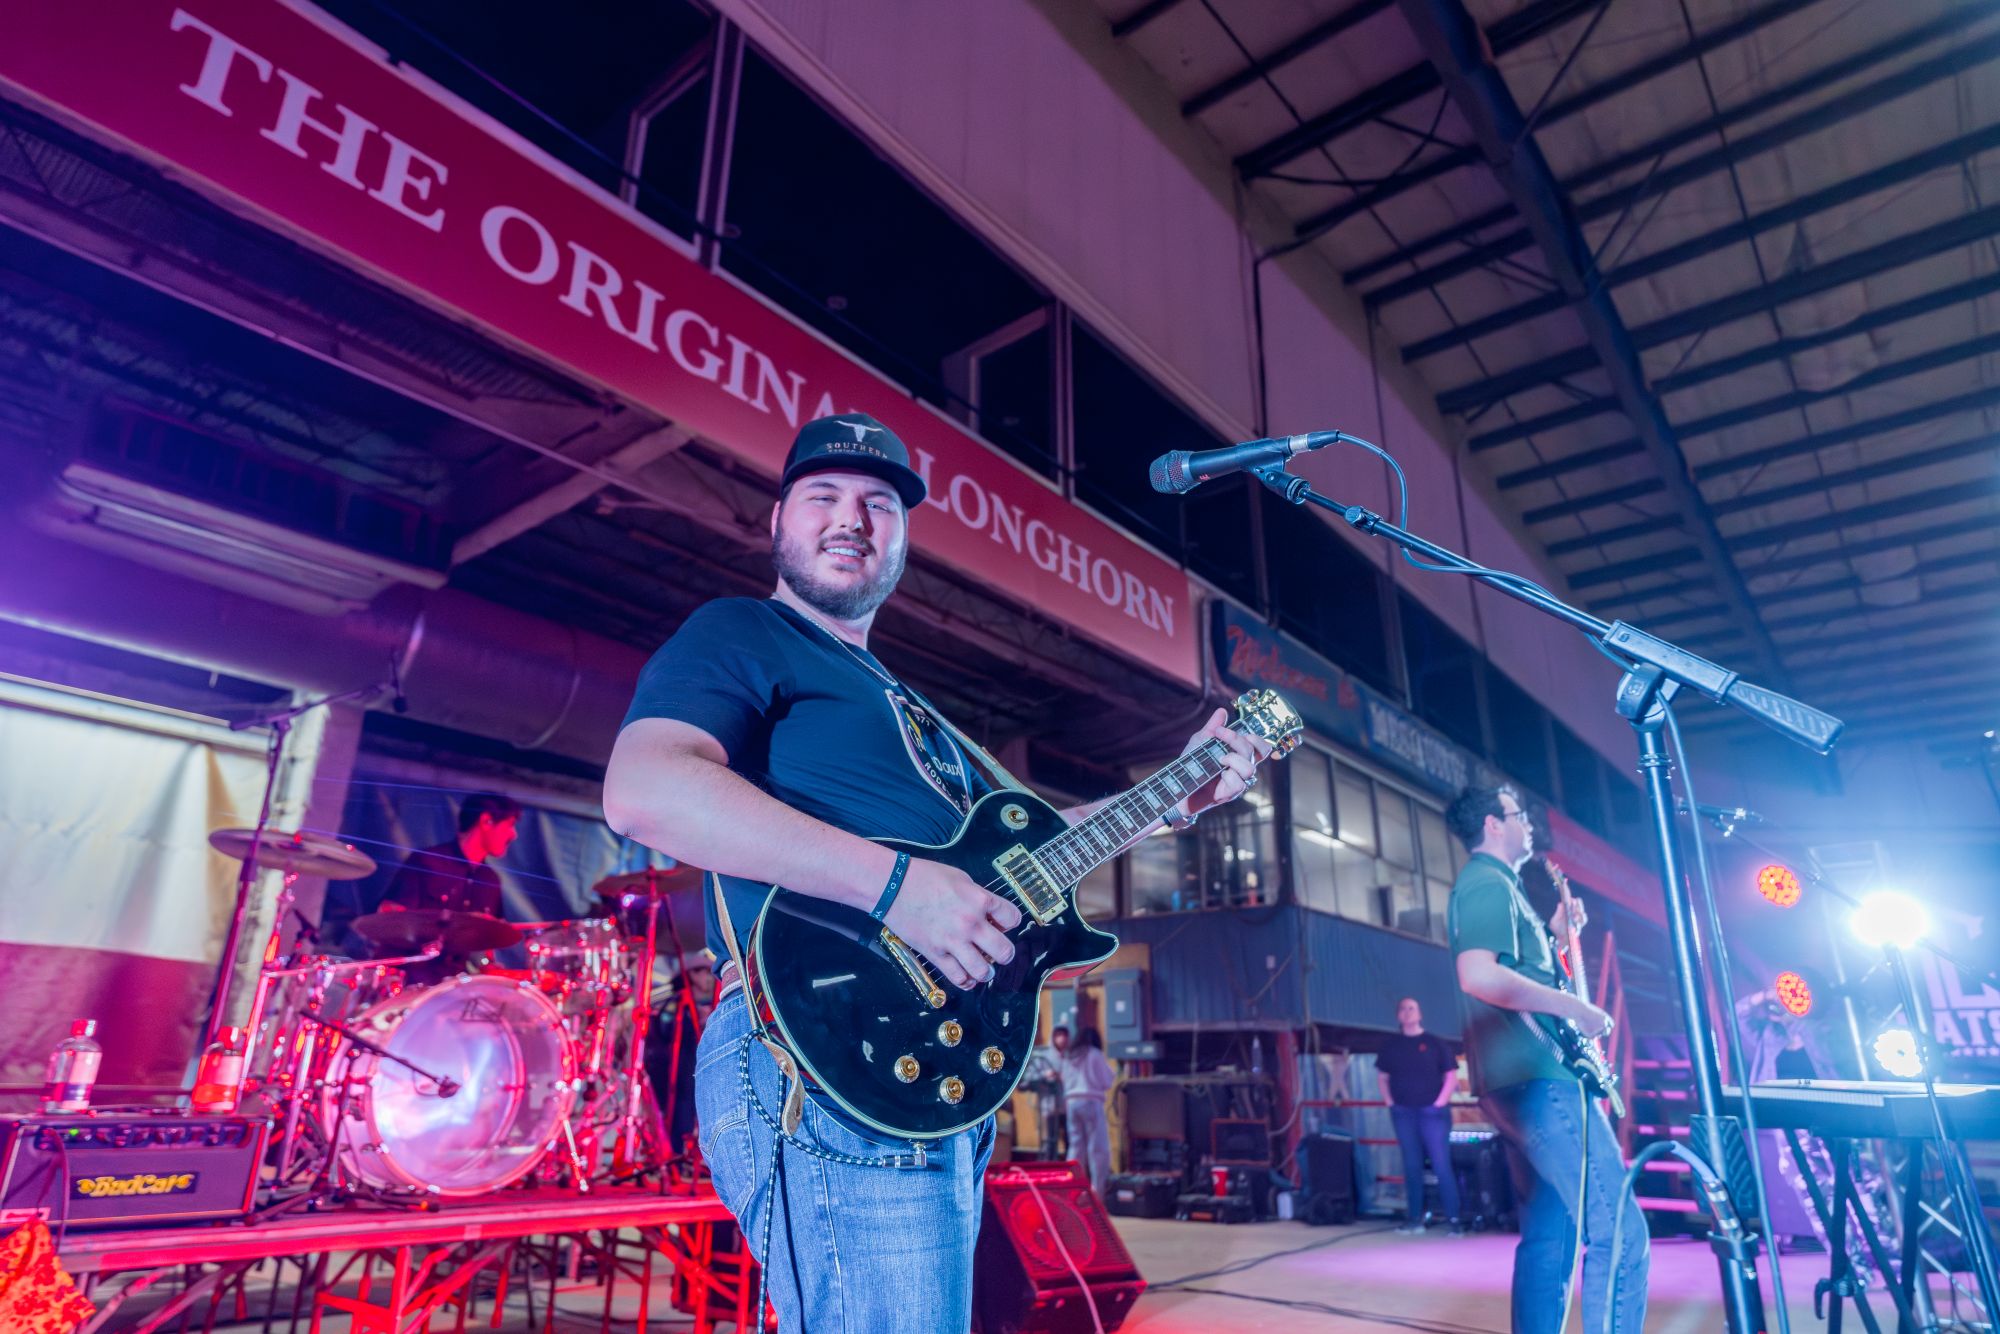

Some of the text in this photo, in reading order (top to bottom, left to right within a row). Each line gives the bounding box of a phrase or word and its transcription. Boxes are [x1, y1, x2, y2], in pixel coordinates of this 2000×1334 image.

[171, 8, 1174, 638] THE ORIGIN LONGHORN
